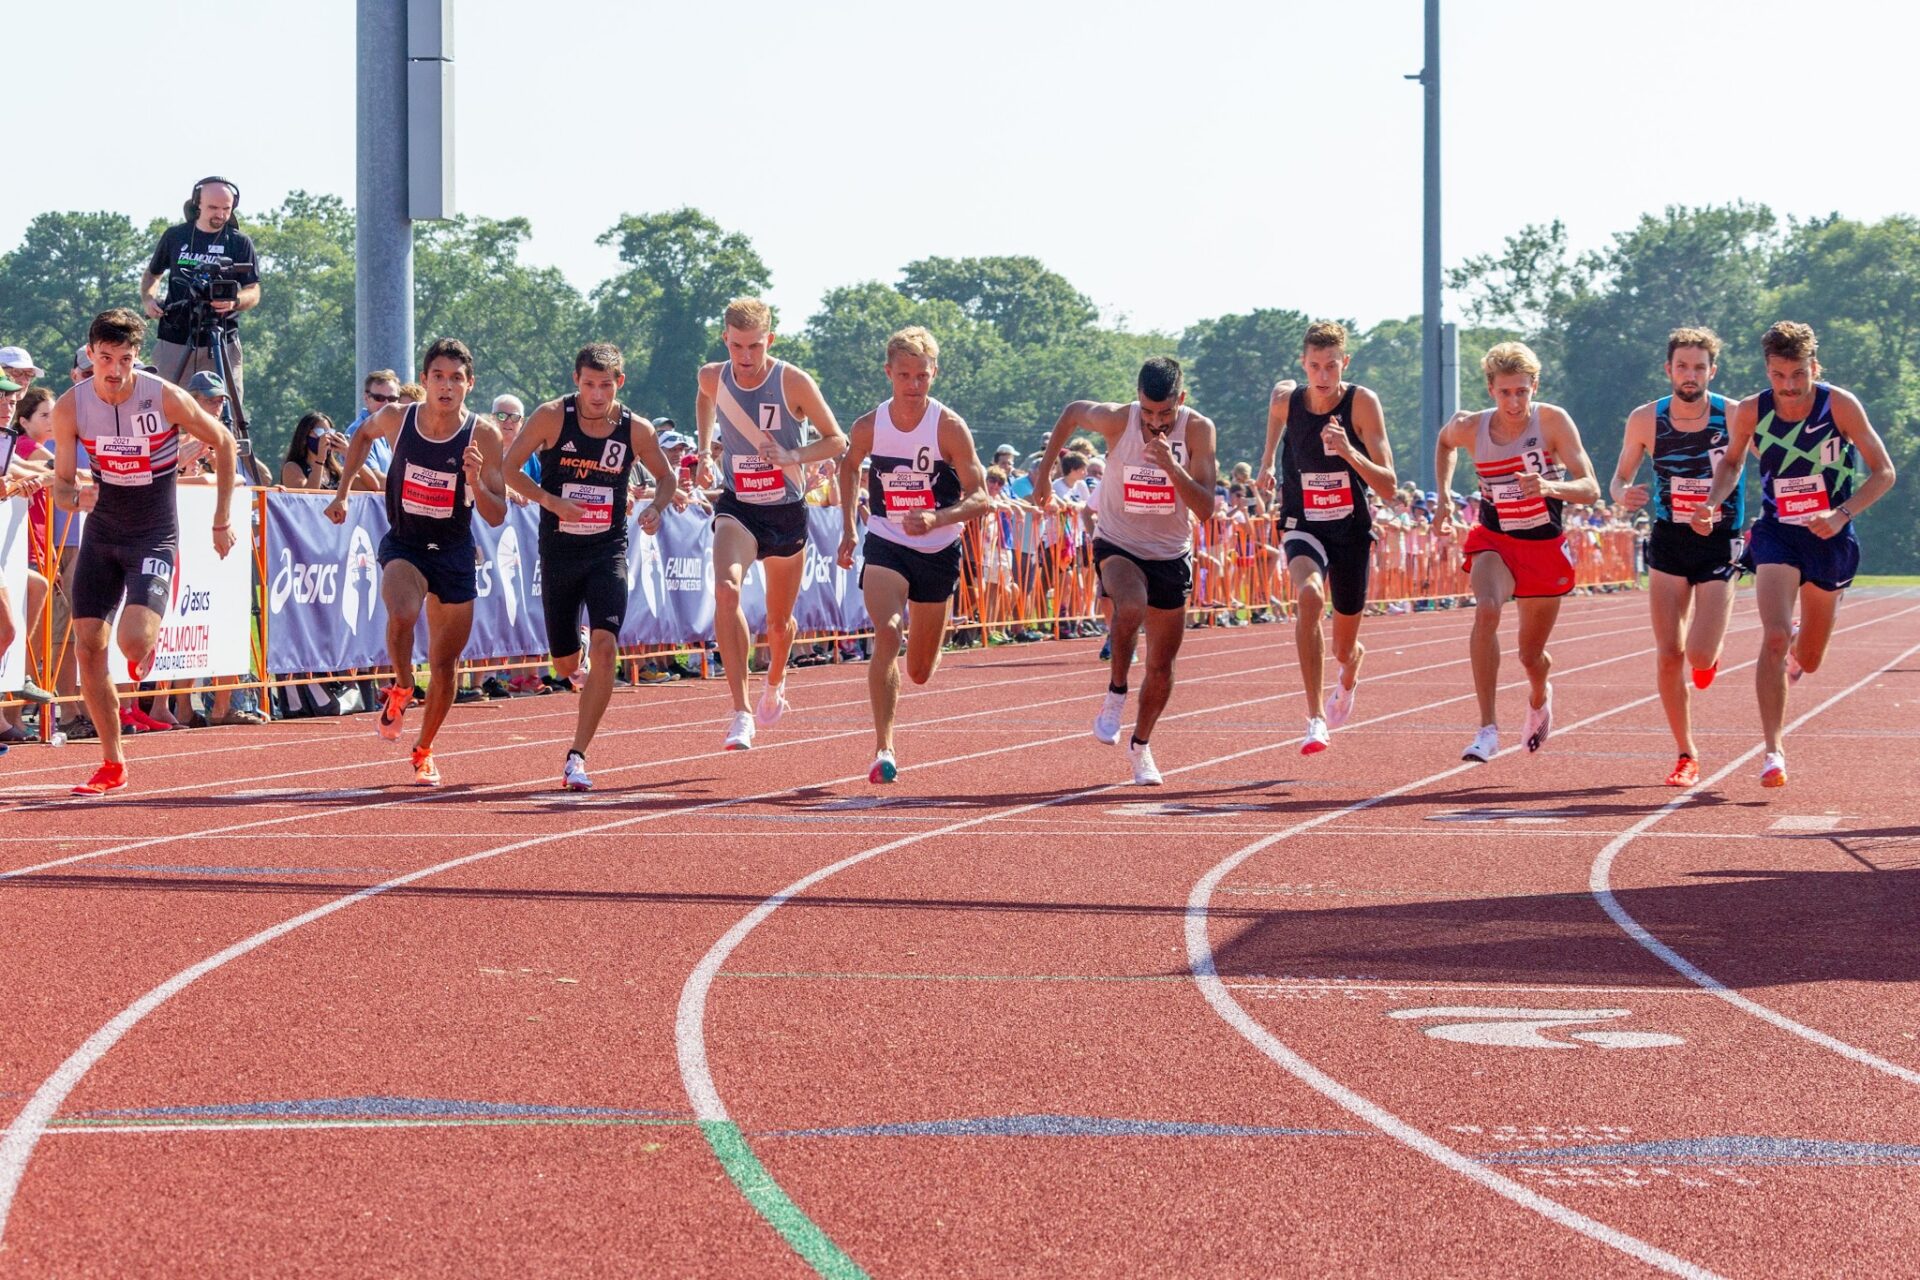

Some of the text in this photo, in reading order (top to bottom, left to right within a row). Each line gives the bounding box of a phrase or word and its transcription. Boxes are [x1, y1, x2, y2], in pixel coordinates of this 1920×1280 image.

[178, 252, 217, 264] FALMOU
[136, 413, 157, 435] 10
[764, 405, 775, 429] 7
[606, 443, 621, 468] 8
[1171, 442, 1182, 463] 5
[1826, 440, 1834, 462] 1
[107, 460, 140, 471] Piazza
[560, 457, 623, 474] MCMIL
[916, 446, 930, 472] 6
[1527, 452, 1542, 474] 3
[421, 469, 438, 478] 2021
[897, 473, 912, 481] 2021
[1139, 468, 1155, 476] 2021
[1315, 473, 1330, 481] 2021
[579, 485, 596, 493] 2021
[742, 476, 775, 490] Meyer
[570, 492, 602, 500] FALMOUTH
[891, 495, 927, 507] Nowak
[1127, 488, 1171, 500] Herrera
[1312, 494, 1342, 506] Ferlic
[1785, 498, 1819, 513] Engels
[581, 509, 609, 519] ards
[149, 559, 167, 576] 10
[293, 563, 339, 604] asics
[190, 591, 210, 611] asics
[156, 625, 209, 653] FALMOUTH
[155, 655, 171, 671] ROAD
[172, 655, 186, 669] RACE
